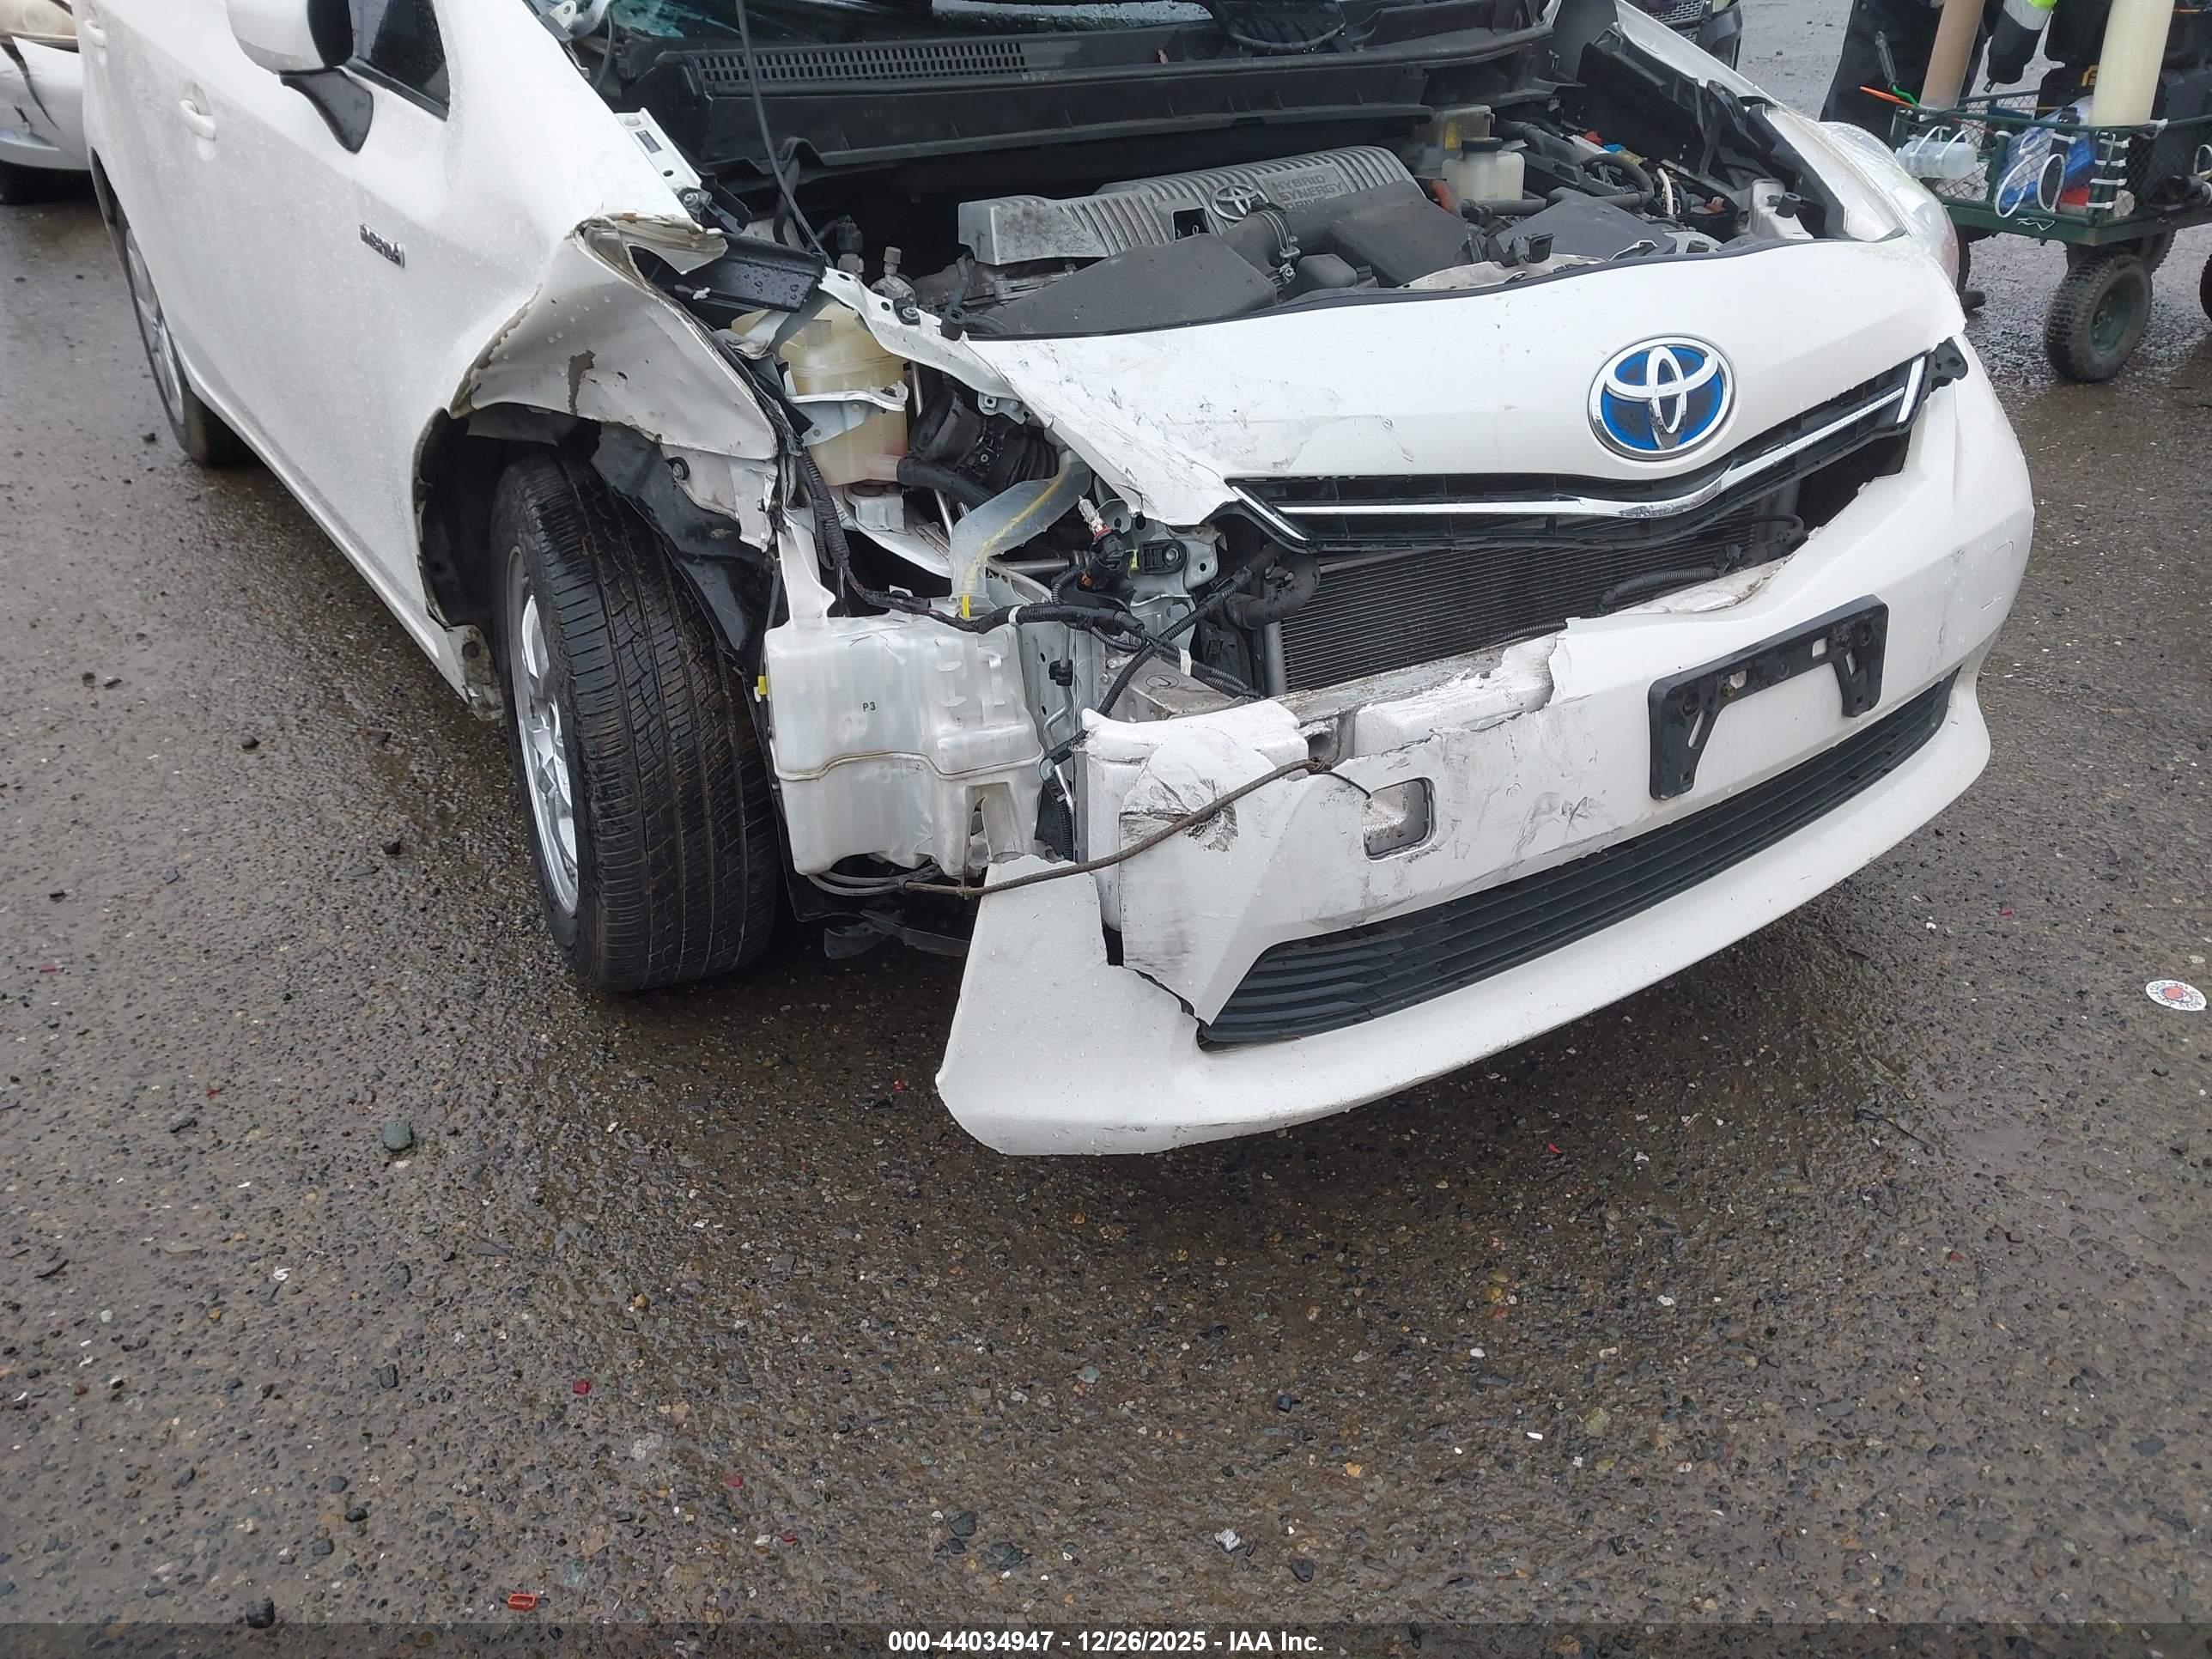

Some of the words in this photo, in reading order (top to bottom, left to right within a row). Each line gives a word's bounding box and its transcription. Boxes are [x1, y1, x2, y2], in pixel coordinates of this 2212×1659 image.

[1273, 174, 1326, 191] HYBRID
[1278, 183, 1343, 201] SYNERGY
[861, 701, 877, 713] P3
